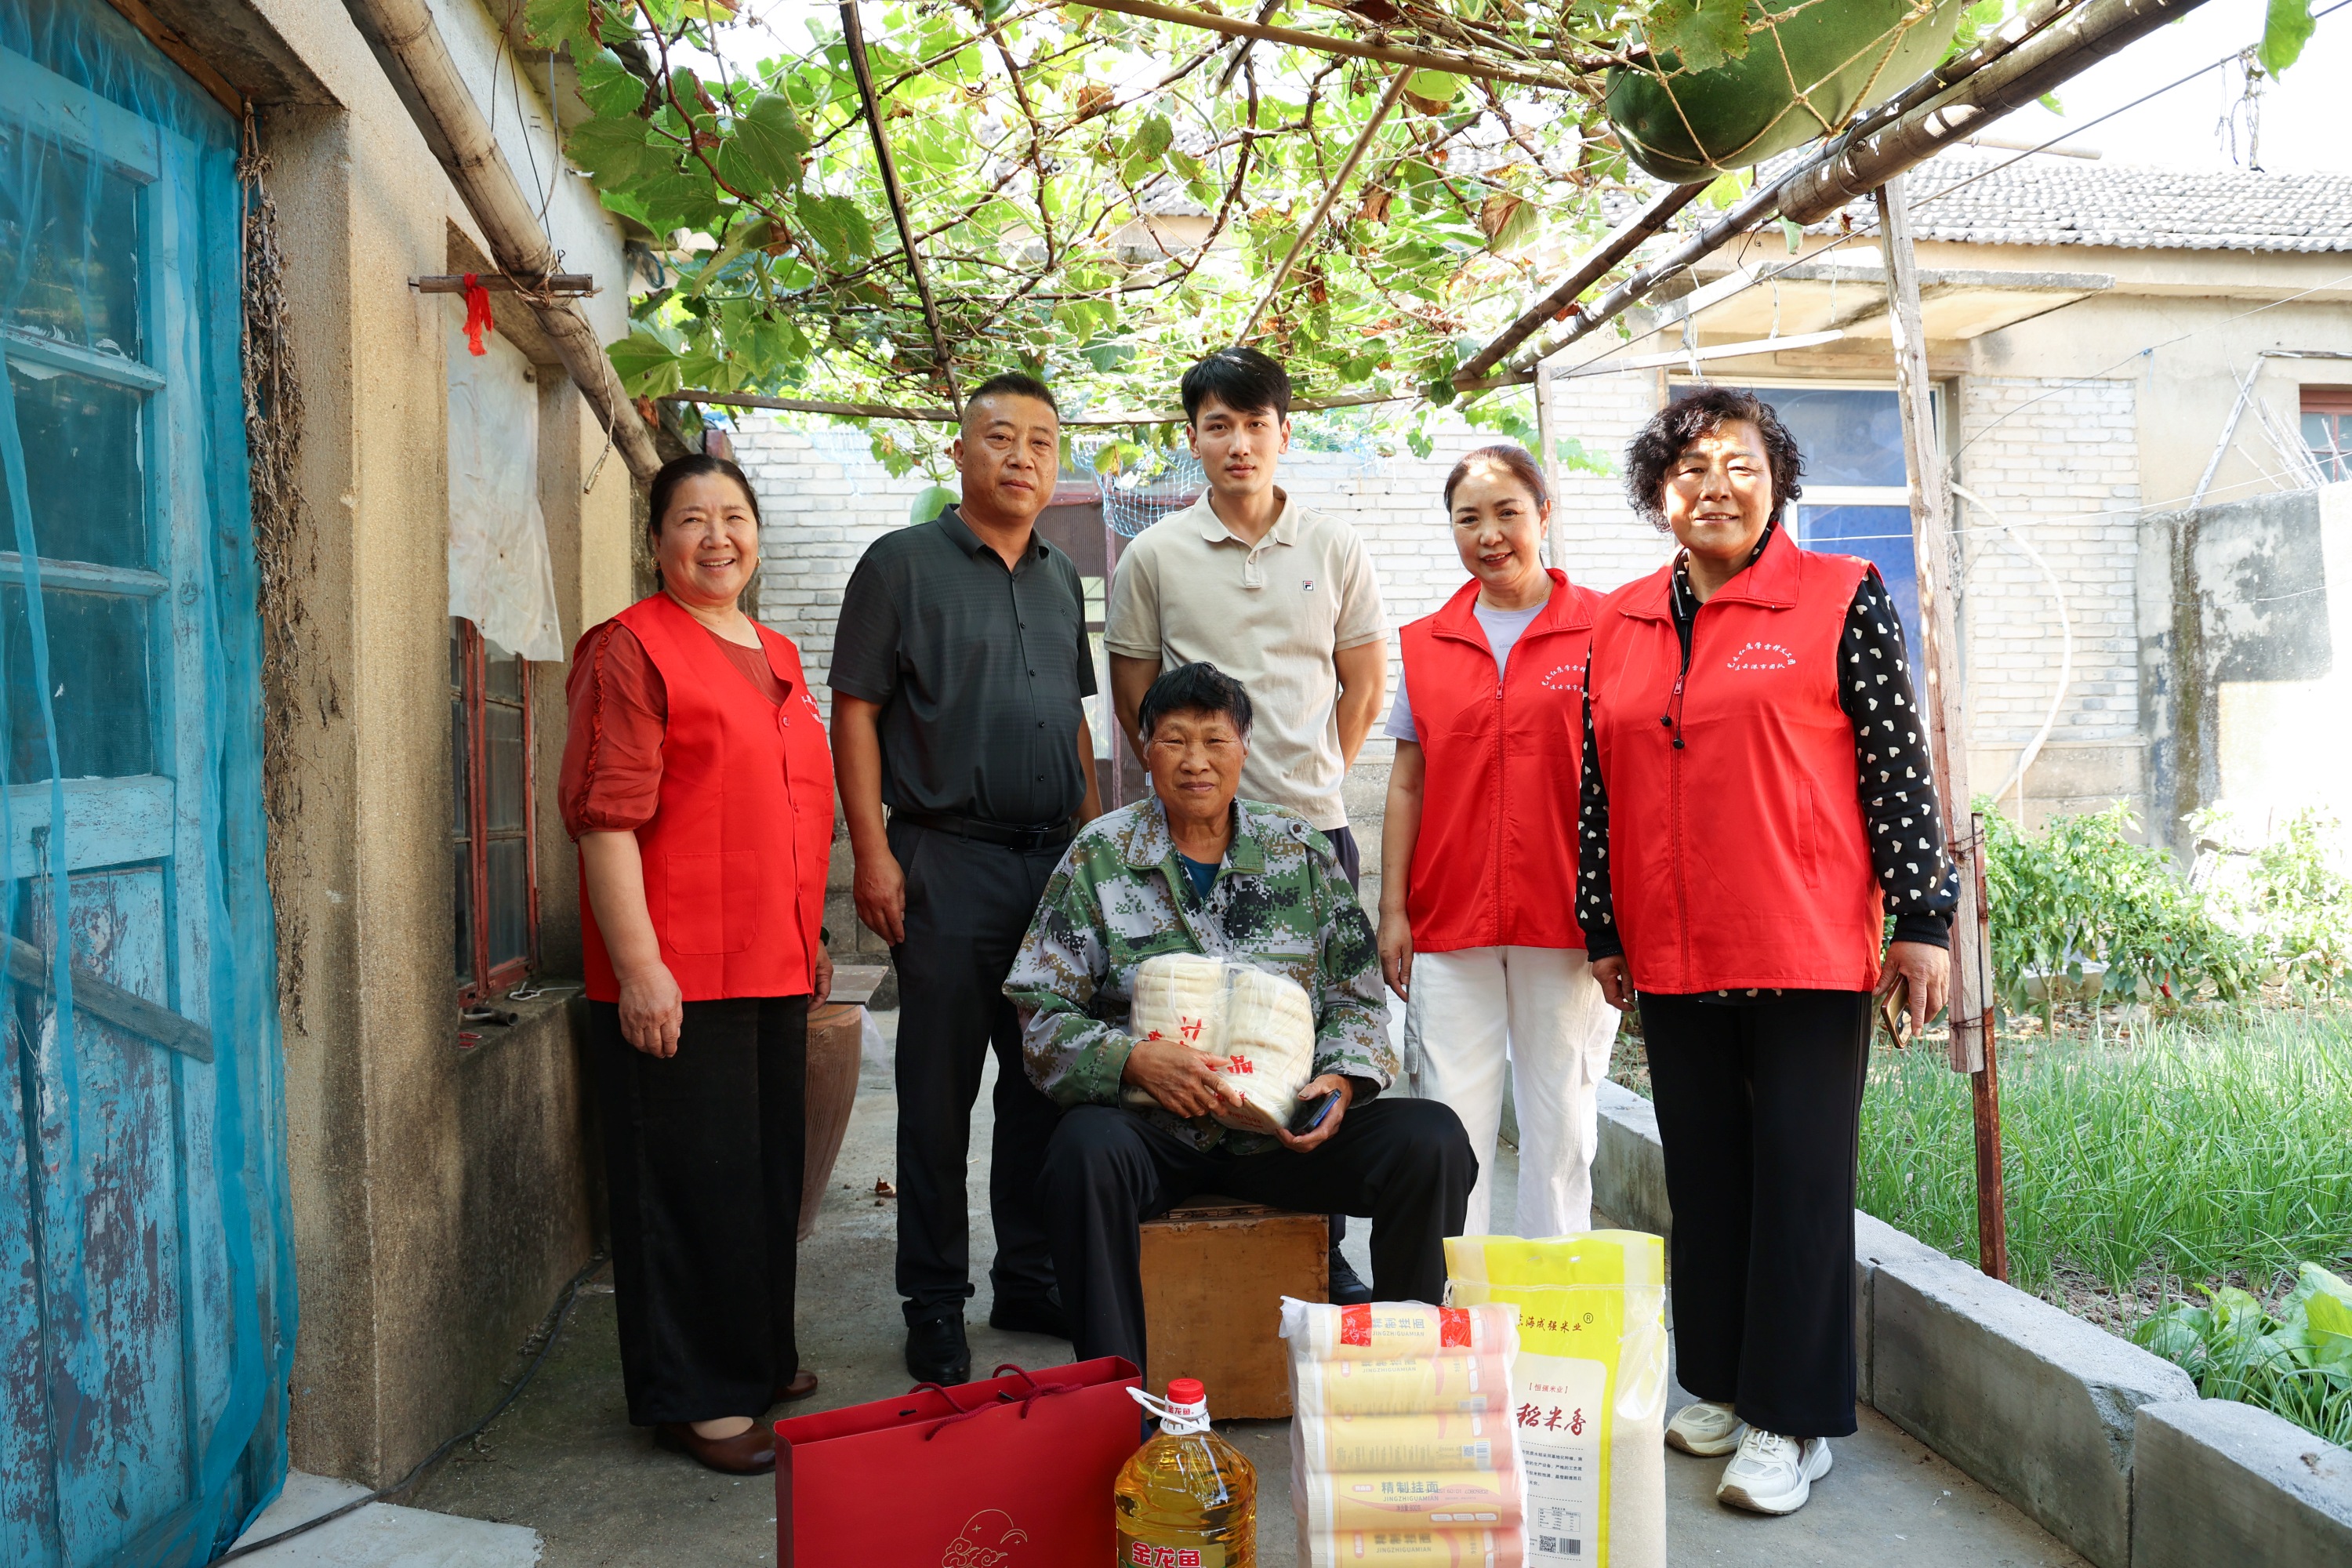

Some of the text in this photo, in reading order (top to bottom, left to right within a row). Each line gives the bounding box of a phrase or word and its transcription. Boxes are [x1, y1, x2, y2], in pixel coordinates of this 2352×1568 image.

[1168, 1405, 1191, 1415] 金龙鱼
[1516, 1403, 1587, 1436] 稻米香
[1381, 1481, 1439, 1494] 精制挂面
[1132, 1541, 1201, 1568] 金龙鱼
